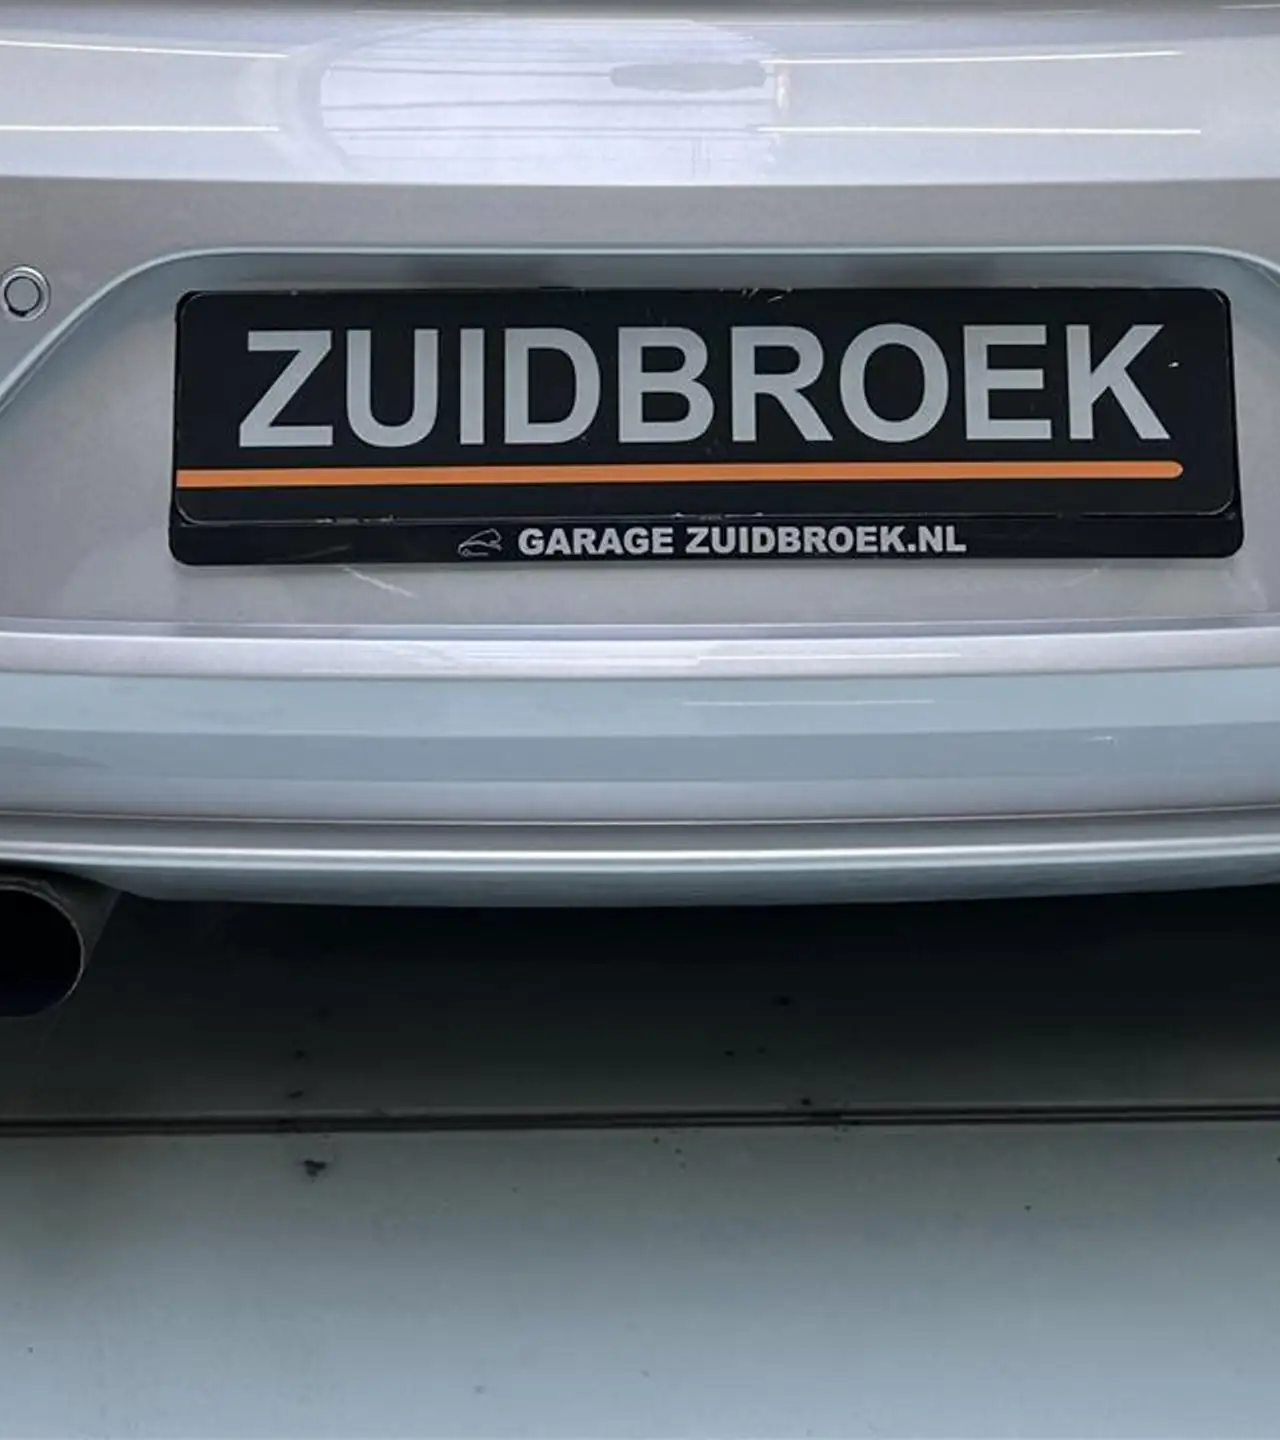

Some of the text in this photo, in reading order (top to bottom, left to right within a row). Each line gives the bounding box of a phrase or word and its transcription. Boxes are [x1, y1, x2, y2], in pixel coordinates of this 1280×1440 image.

[238, 323, 1170, 448] ZUIDBROEK
[518, 525, 967, 556] GARAGE ZUIDBROEK.NL
